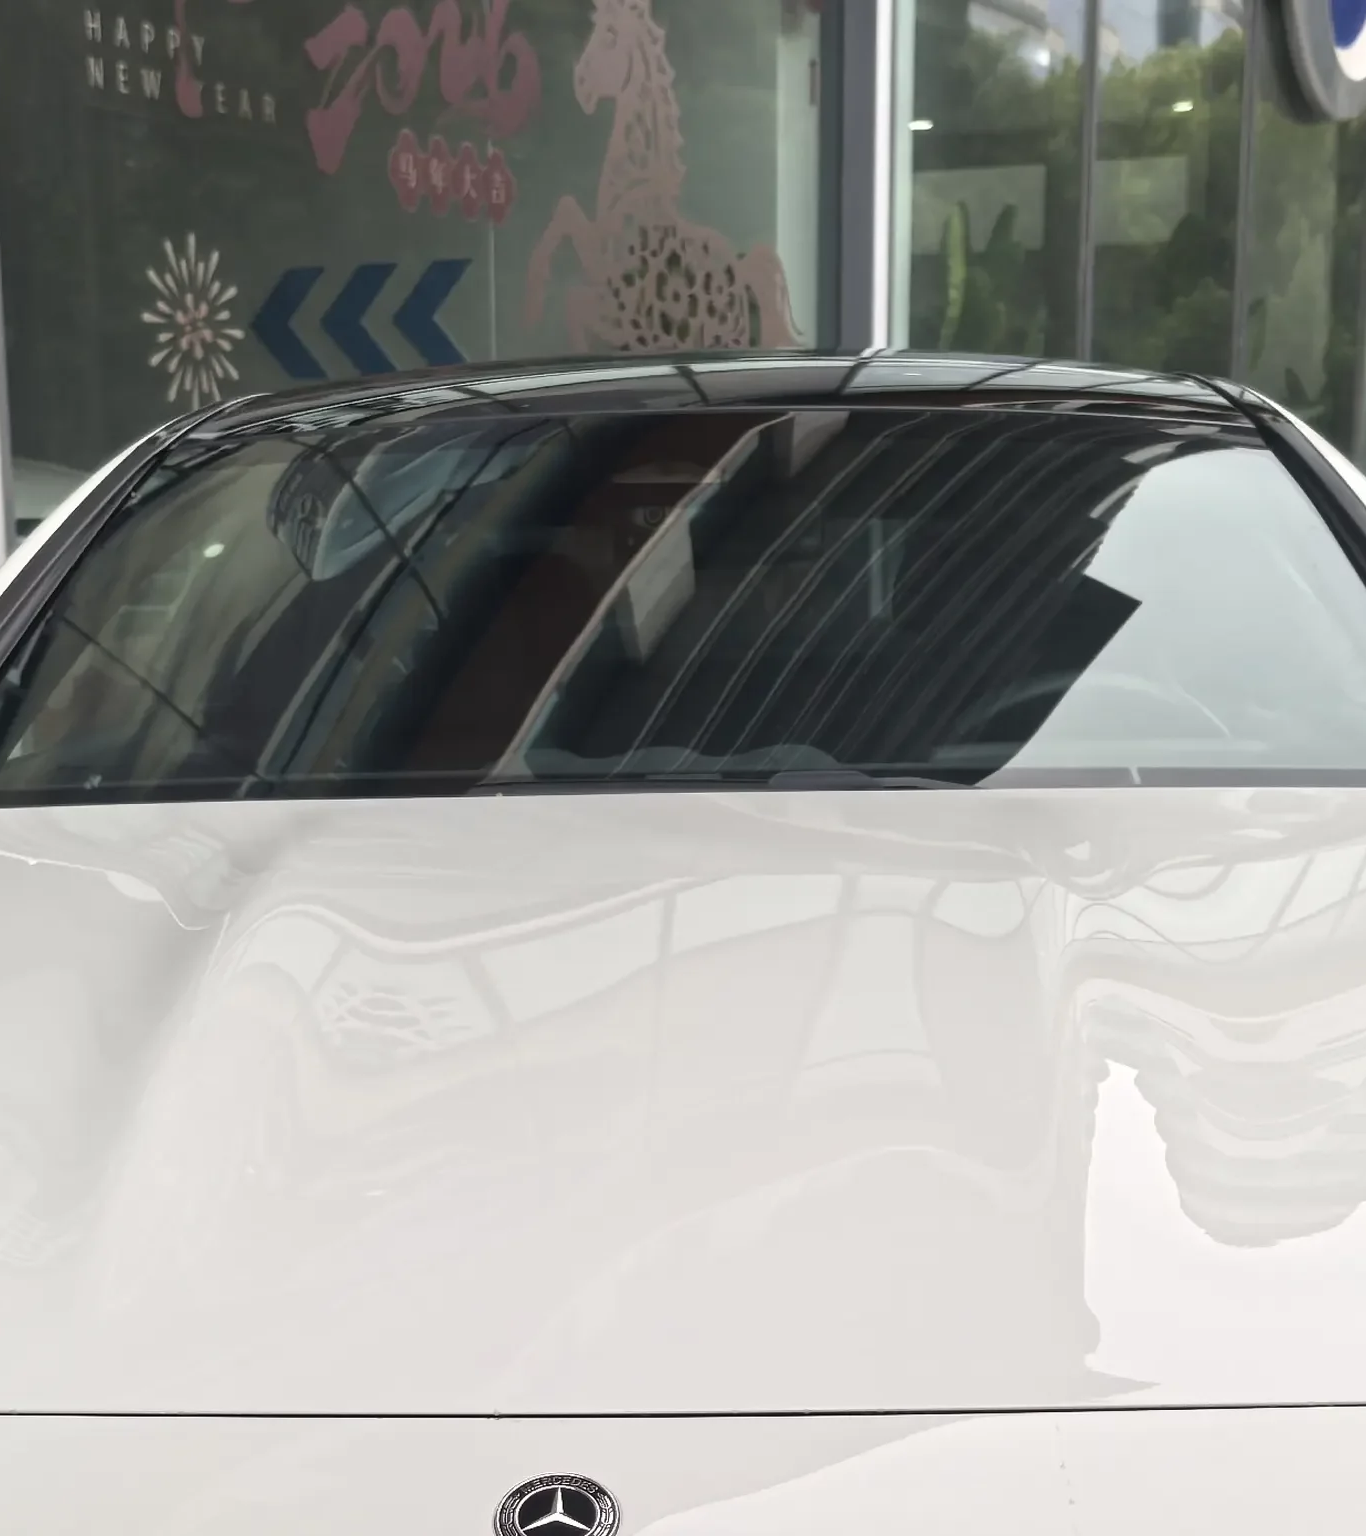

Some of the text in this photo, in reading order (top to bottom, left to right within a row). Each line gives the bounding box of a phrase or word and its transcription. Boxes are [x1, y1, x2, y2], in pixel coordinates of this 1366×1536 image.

[85, 9, 205, 67] HAPPY
[88, 56, 277, 127] NEW EAR
[522, 1475, 599, 1495] MERCEDES
